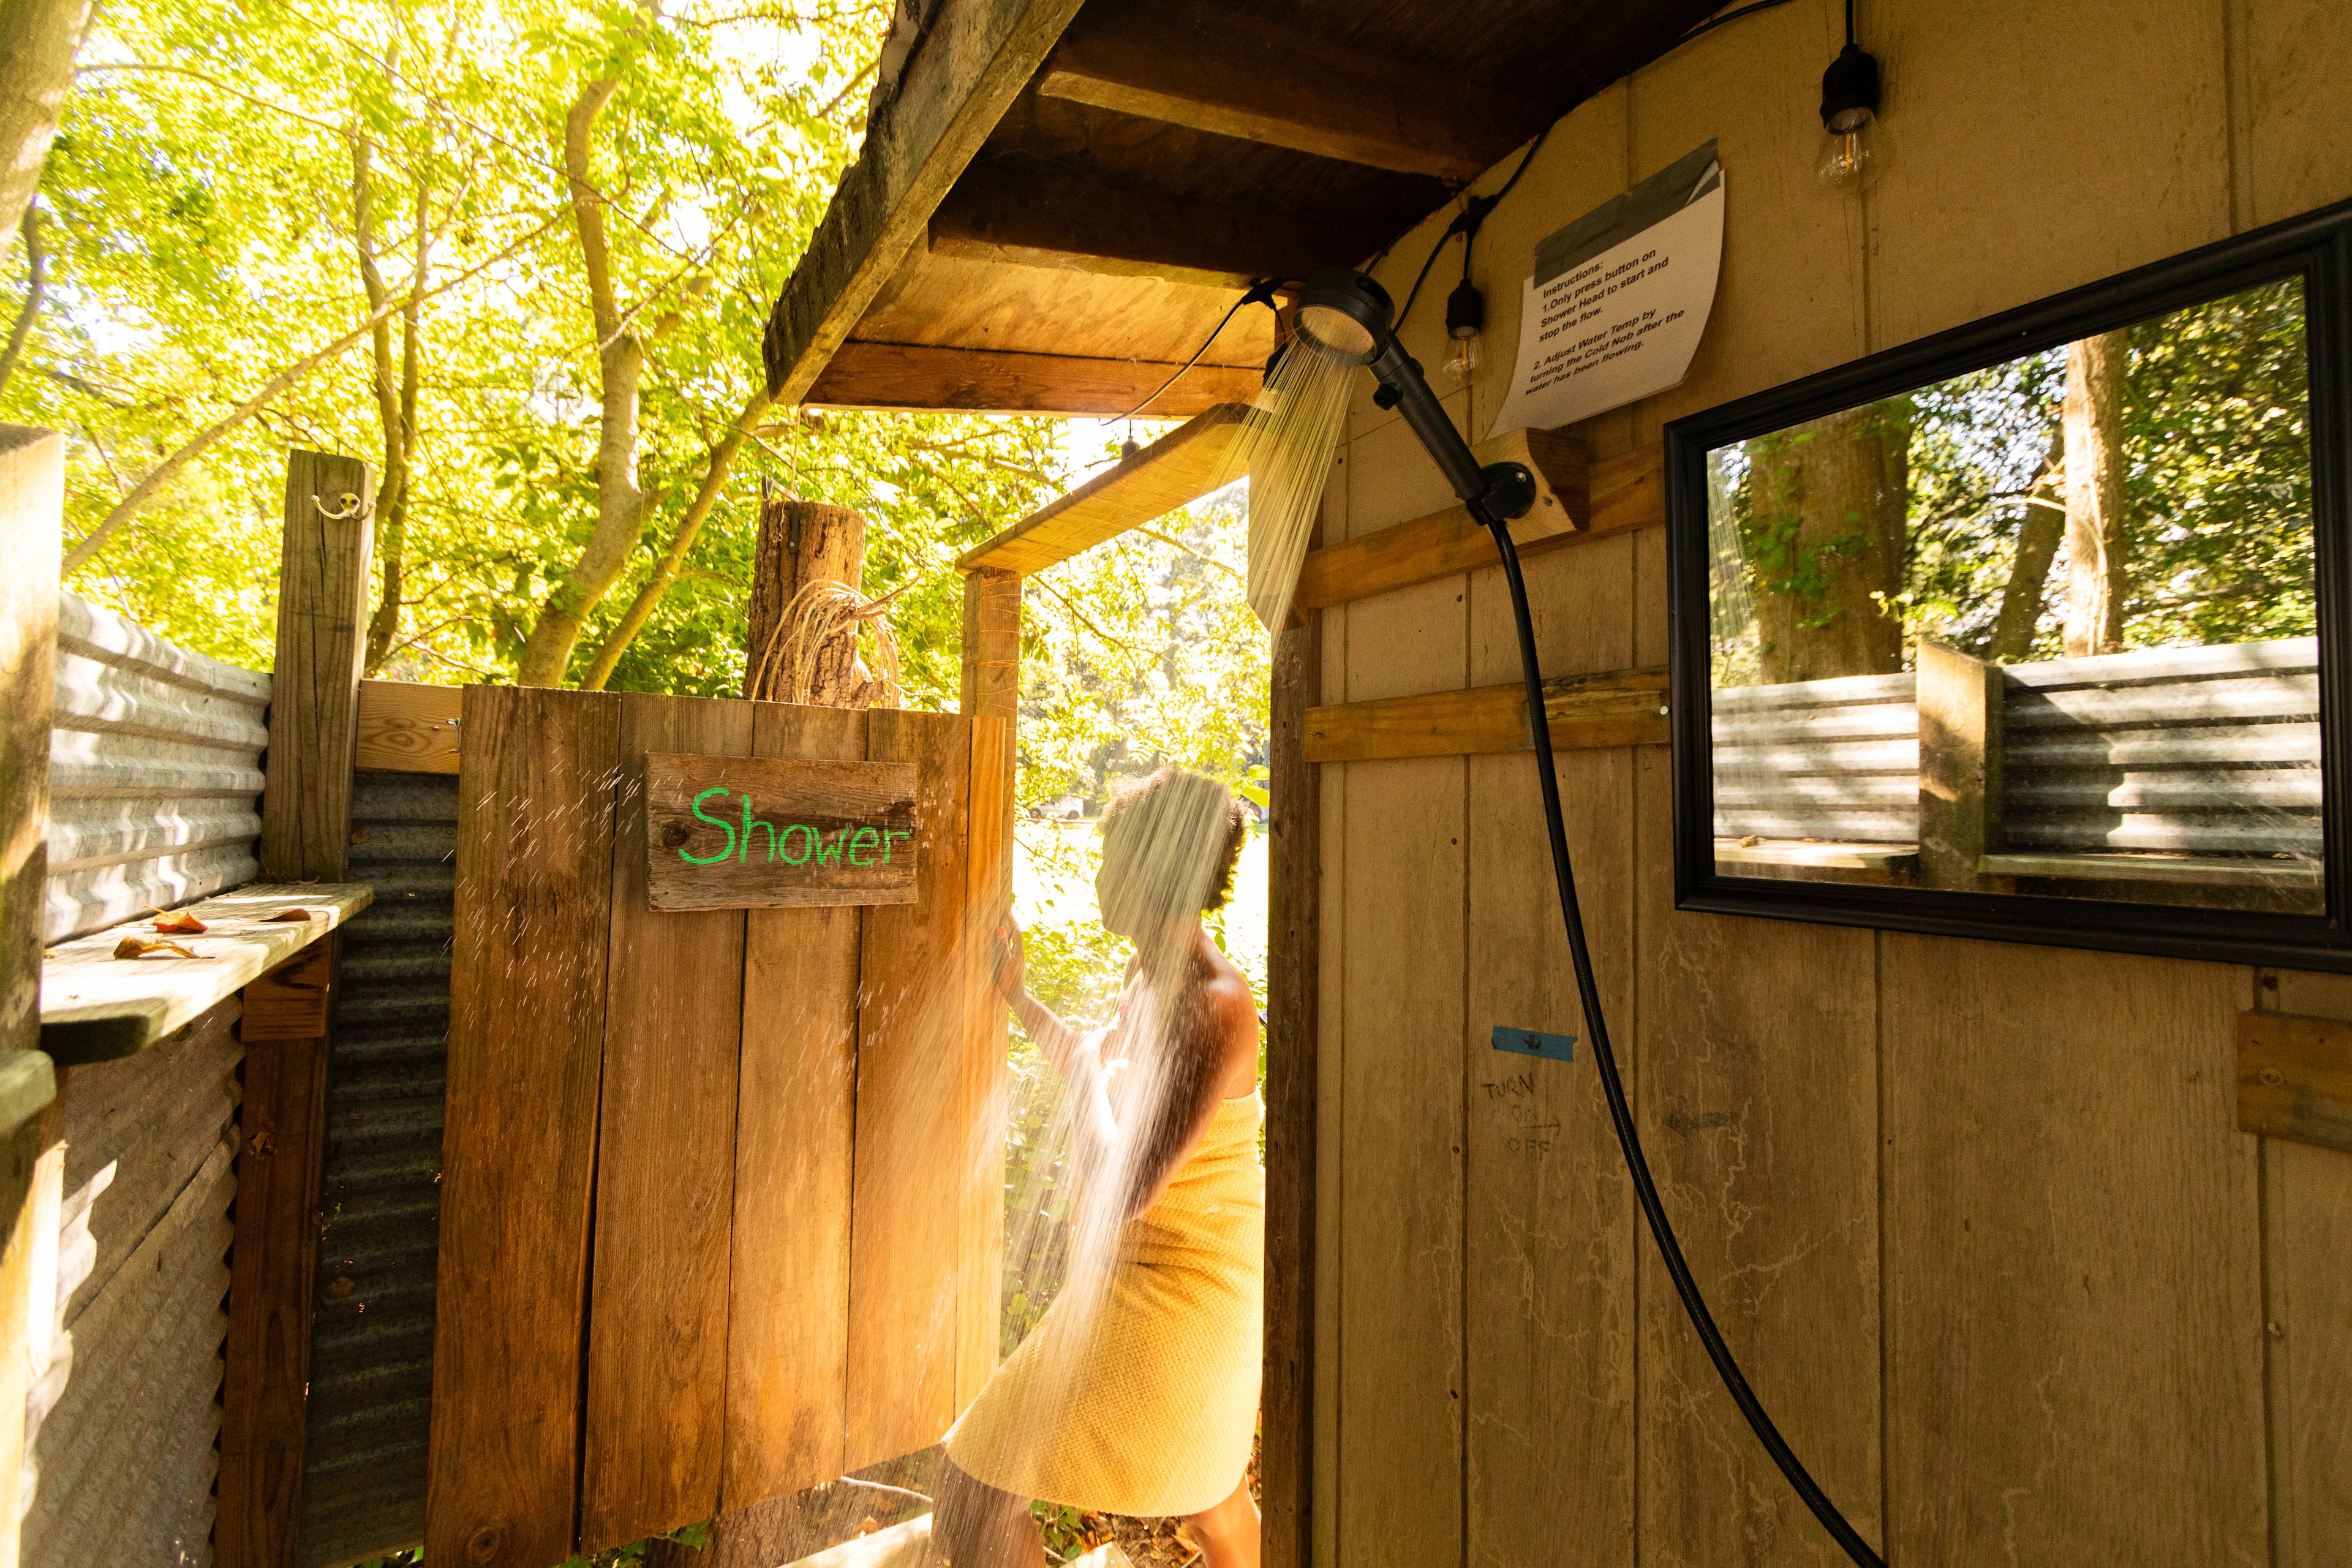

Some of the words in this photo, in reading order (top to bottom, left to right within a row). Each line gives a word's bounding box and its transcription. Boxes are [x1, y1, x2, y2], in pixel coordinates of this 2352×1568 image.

[1541, 305, 1577, 328] Shower
[1579, 289, 1604, 307] Head
[1607, 284, 1617, 295] to
[1620, 270, 1645, 288] start
[1648, 257, 1668, 275] and
[1542, 292, 1572, 313] 1.Only
[1575, 279, 1602, 298] press
[1605, 257, 1638, 281] button
[1642, 249, 1656, 262] on
[1543, 261, 1604, 298] Instructions:
[1530, 363, 1564, 383] turning
[1567, 353, 1581, 367] the
[1585, 342, 1610, 359] Cold
[1612, 331, 1634, 347] Nob
[1636, 318, 1664, 337] after
[1665, 309, 1684, 325] the
[1539, 325, 1559, 343] stop
[1562, 317, 1577, 330] the
[1580, 307, 1603, 323] flow.
[1544, 344, 1576, 368] Adjust
[1578, 331, 1607, 350] Water
[1611, 317, 1639, 334] Temp
[1642, 309, 1657, 322] by
[1526, 380, 1551, 395] water
[1553, 371, 1570, 383] has
[1574, 358, 1599, 375] been
[1602, 342, 1644, 363] flowing.
[677, 786, 910, 866] Shower
[1507, 1137, 1551, 1161] OFF
